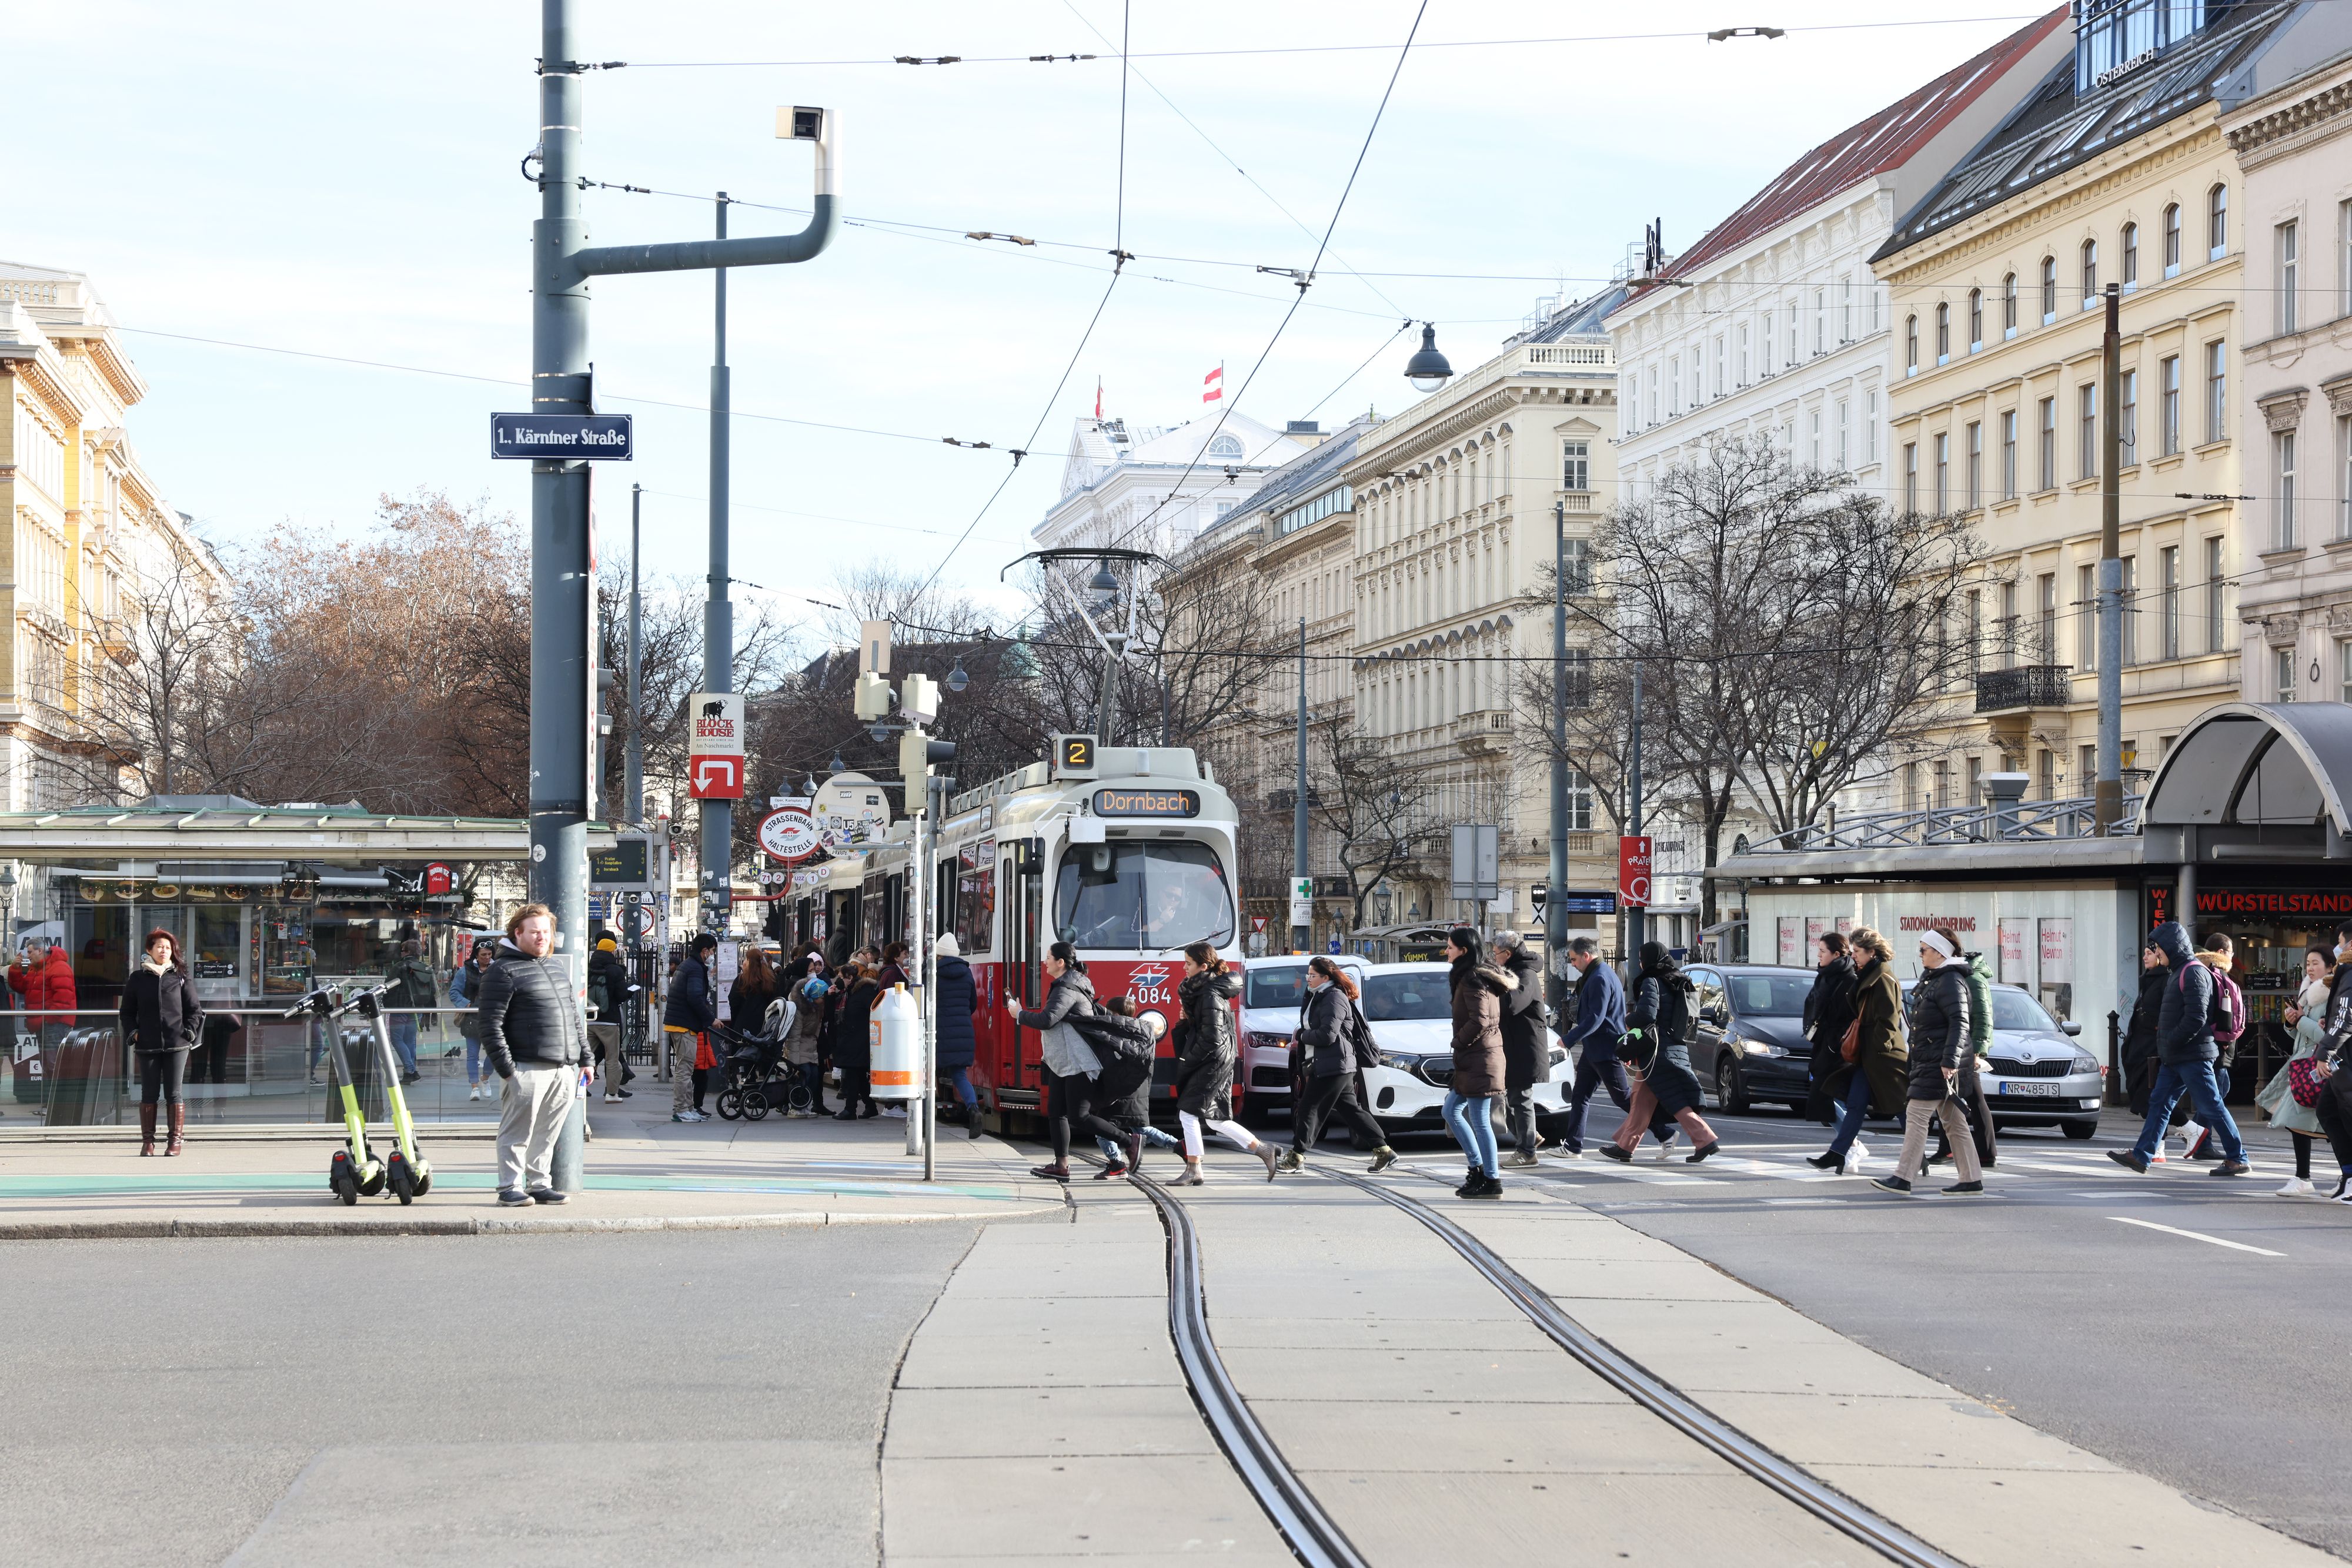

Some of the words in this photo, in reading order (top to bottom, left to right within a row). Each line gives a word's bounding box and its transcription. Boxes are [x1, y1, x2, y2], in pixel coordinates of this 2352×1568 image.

[2095, 48, 2156, 88] ÖSTERREICH
[497, 427, 512, 444] 1.,
[515, 428, 578, 444] Kärntner
[581, 429, 626, 445] Straße
[696, 719, 734, 728] BLOCK
[696, 728, 734, 737] HOUSE
[1070, 743, 1085, 763] 2
[1104, 791, 1189, 811] Dornbach
[766, 815, 813, 831] STRASSENBAHN
[843, 821, 854, 830] U5
[767, 839, 813, 853] HALTESTELLE
[1628, 856, 1652, 865] PRATER
[2197, 890, 2352, 912] WÜRSTELSTAND
[2152, 889, 2167, 928] WIEN
[1809, 921, 1823, 932] Helmut
[1900, 917, 1926, 931] STATION
[1959, 917, 1976, 931] RING
[1780, 927, 1794, 938] Helmut
[2002, 930, 2020, 943] Helmut
[2042, 928, 2061, 942] Helmut
[1780, 941, 1794, 951] Newton
[2002, 946, 2022, 960] Newton
[2042, 945, 2062, 959] Newton
[1126, 988, 1171, 1004] 4084
[2007, 1084, 2020, 1094] NR
